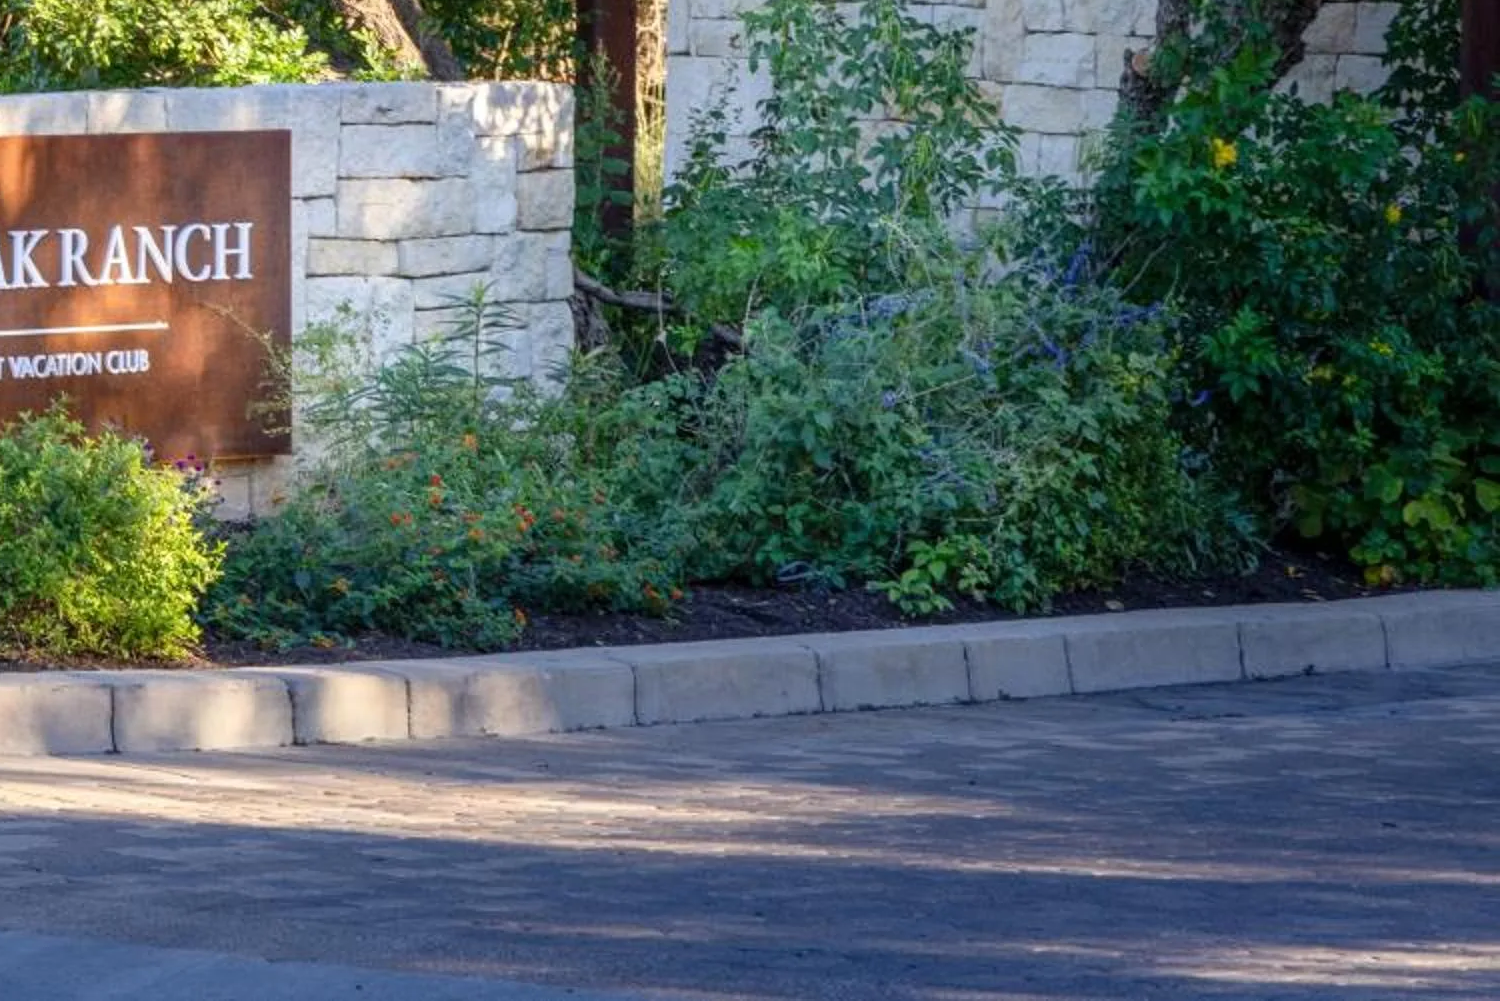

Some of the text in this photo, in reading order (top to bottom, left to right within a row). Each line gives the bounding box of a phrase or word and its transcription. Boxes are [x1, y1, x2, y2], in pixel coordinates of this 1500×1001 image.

[58, 222, 254, 287] RANCH
[8, 351, 101, 378] VACATION
[105, 349, 150, 374] CLUB
